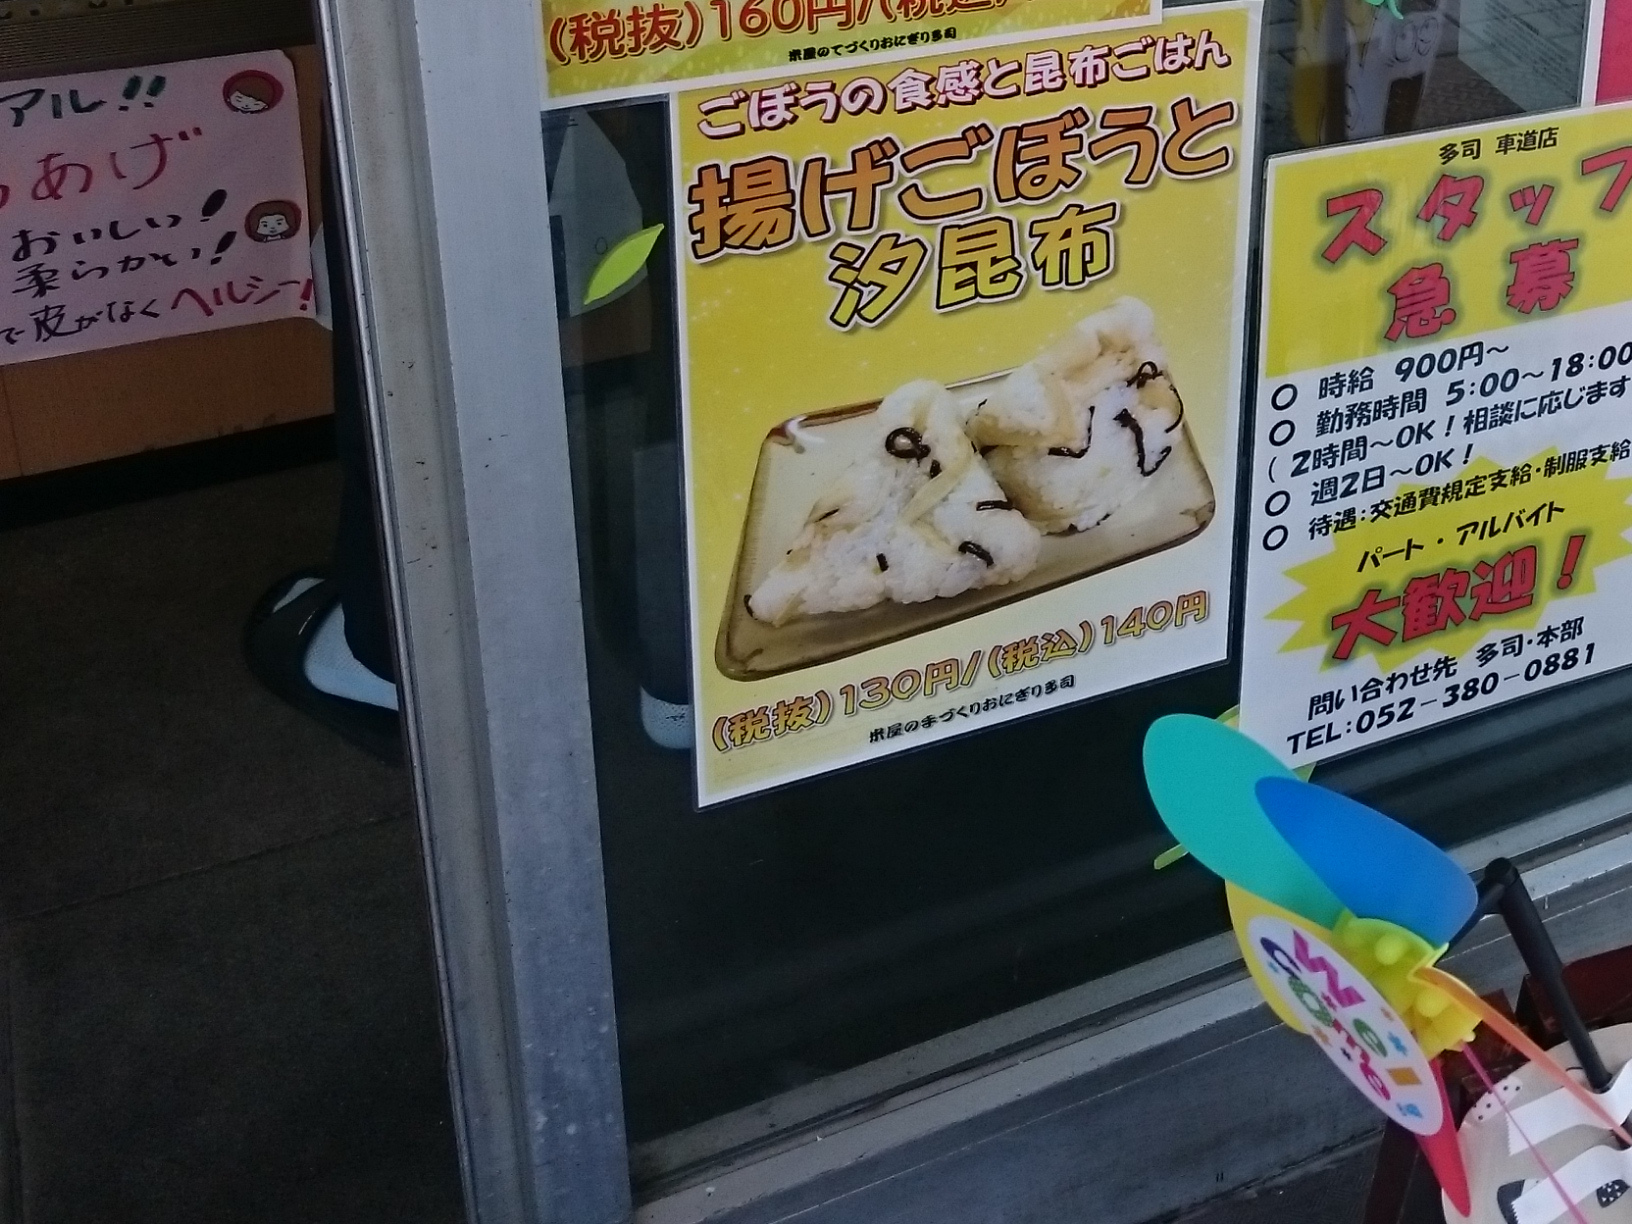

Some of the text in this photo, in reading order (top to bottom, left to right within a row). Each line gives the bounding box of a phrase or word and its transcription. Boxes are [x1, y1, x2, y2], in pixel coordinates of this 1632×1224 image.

[698, 28, 1232, 140] ごぼうの食感と昆布ごはん
[689, 98, 1240, 259] 揚げごぼうと
[1439, 127, 1559, 164] 多司 車道店
[12, 189, 227, 261] おいしい!
[828, 199, 1123, 330] 汐昆布
[1383, 238, 1580, 342] 急募
[1315, 387, 1427, 439] 勤務時間
[1318, 340, 1510, 401] 時給 900円~
[1308, 438, 1632, 541] 待遇:交通費規定支給・制服支給
[1310, 443, 1473, 507] 週2日~OK!
[1357, 500, 1566, 573] パート・アルバイト
[1331, 533, 1587, 661] 大歓迎!
[711, 590, 1210, 752] (税抜)130円/(税込)140円
[868, 674, 1076, 745] 米屋の手づくりおにぎり多司
[1308, 615, 1585, 721] 問い合わせ先 多司・本部
